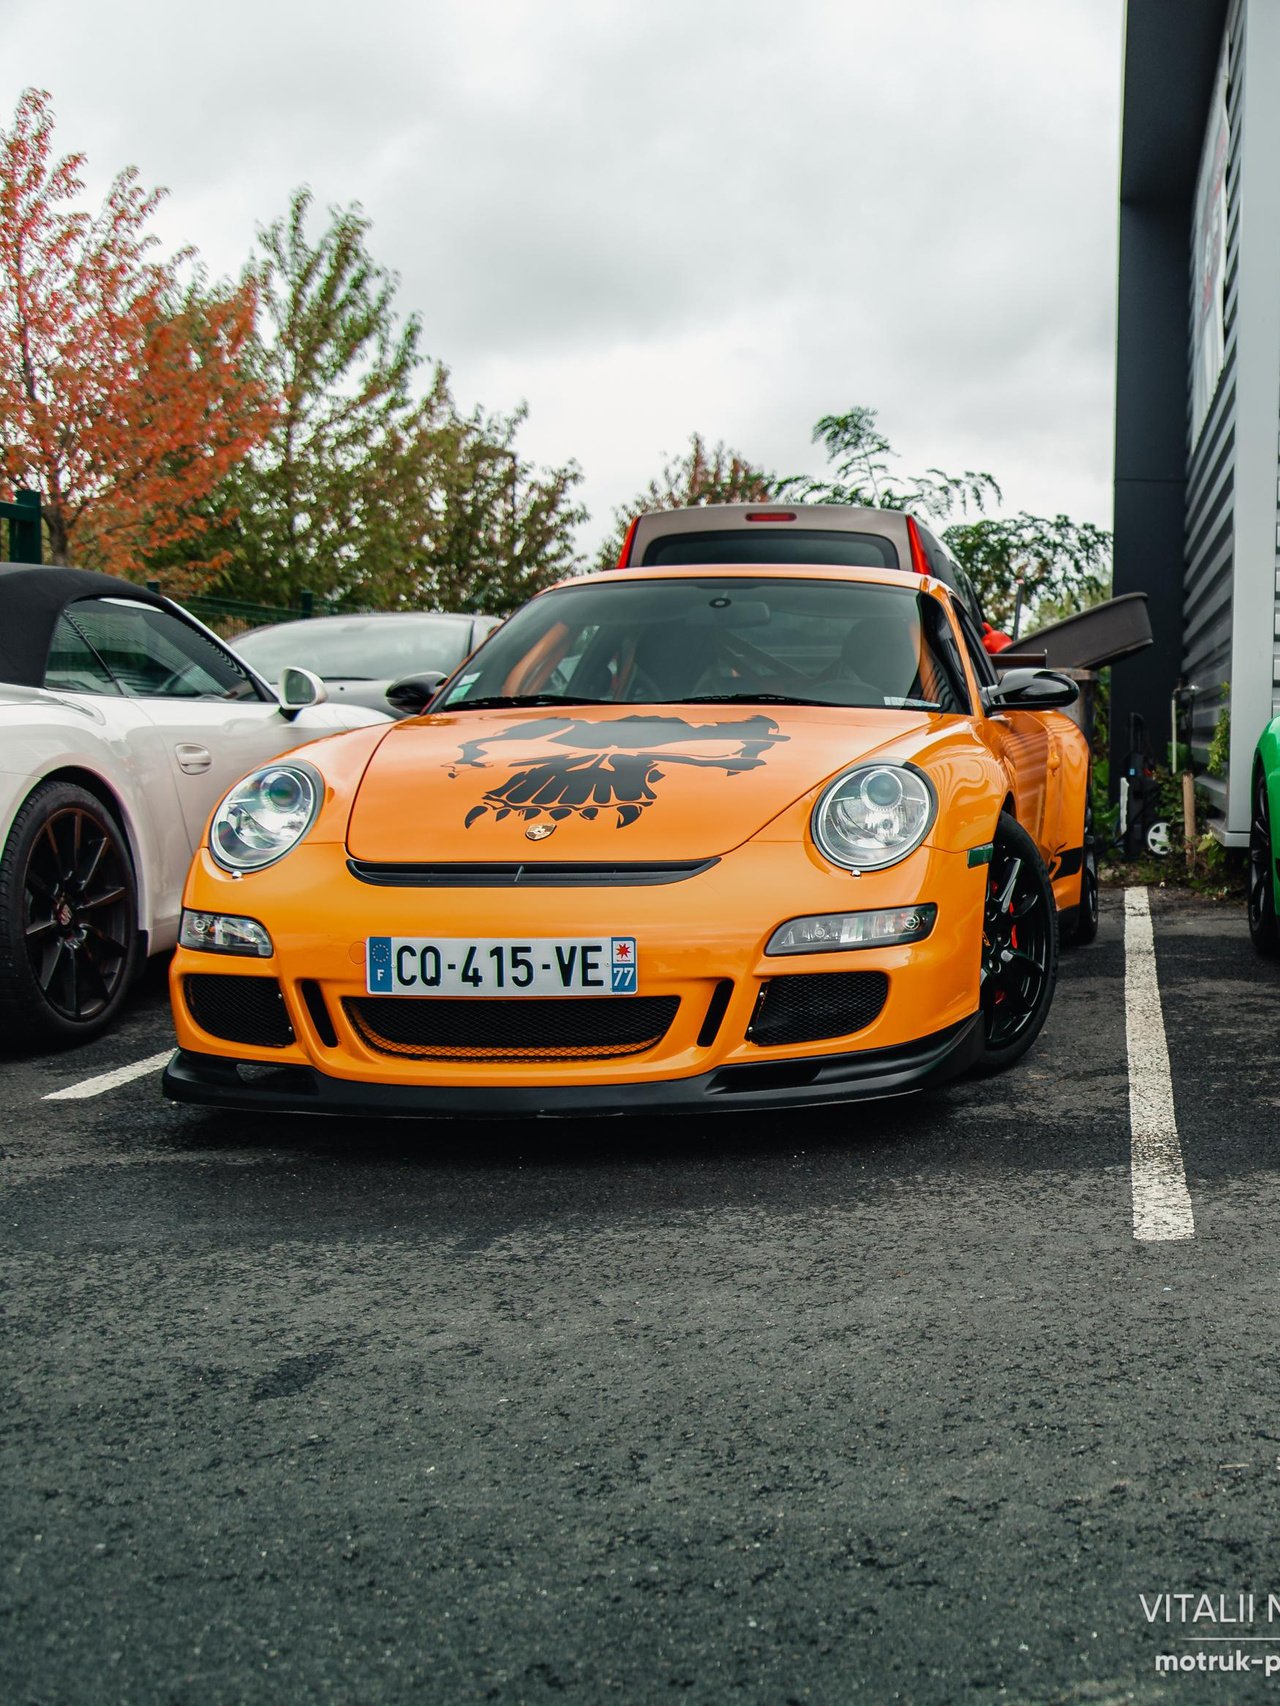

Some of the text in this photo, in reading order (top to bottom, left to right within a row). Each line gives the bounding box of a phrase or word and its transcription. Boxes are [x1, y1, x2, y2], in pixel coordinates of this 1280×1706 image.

[377, 969, 385, 982] F
[396, 945, 604, 988] CQ-415-VE
[613, 967, 635, 987] 77
